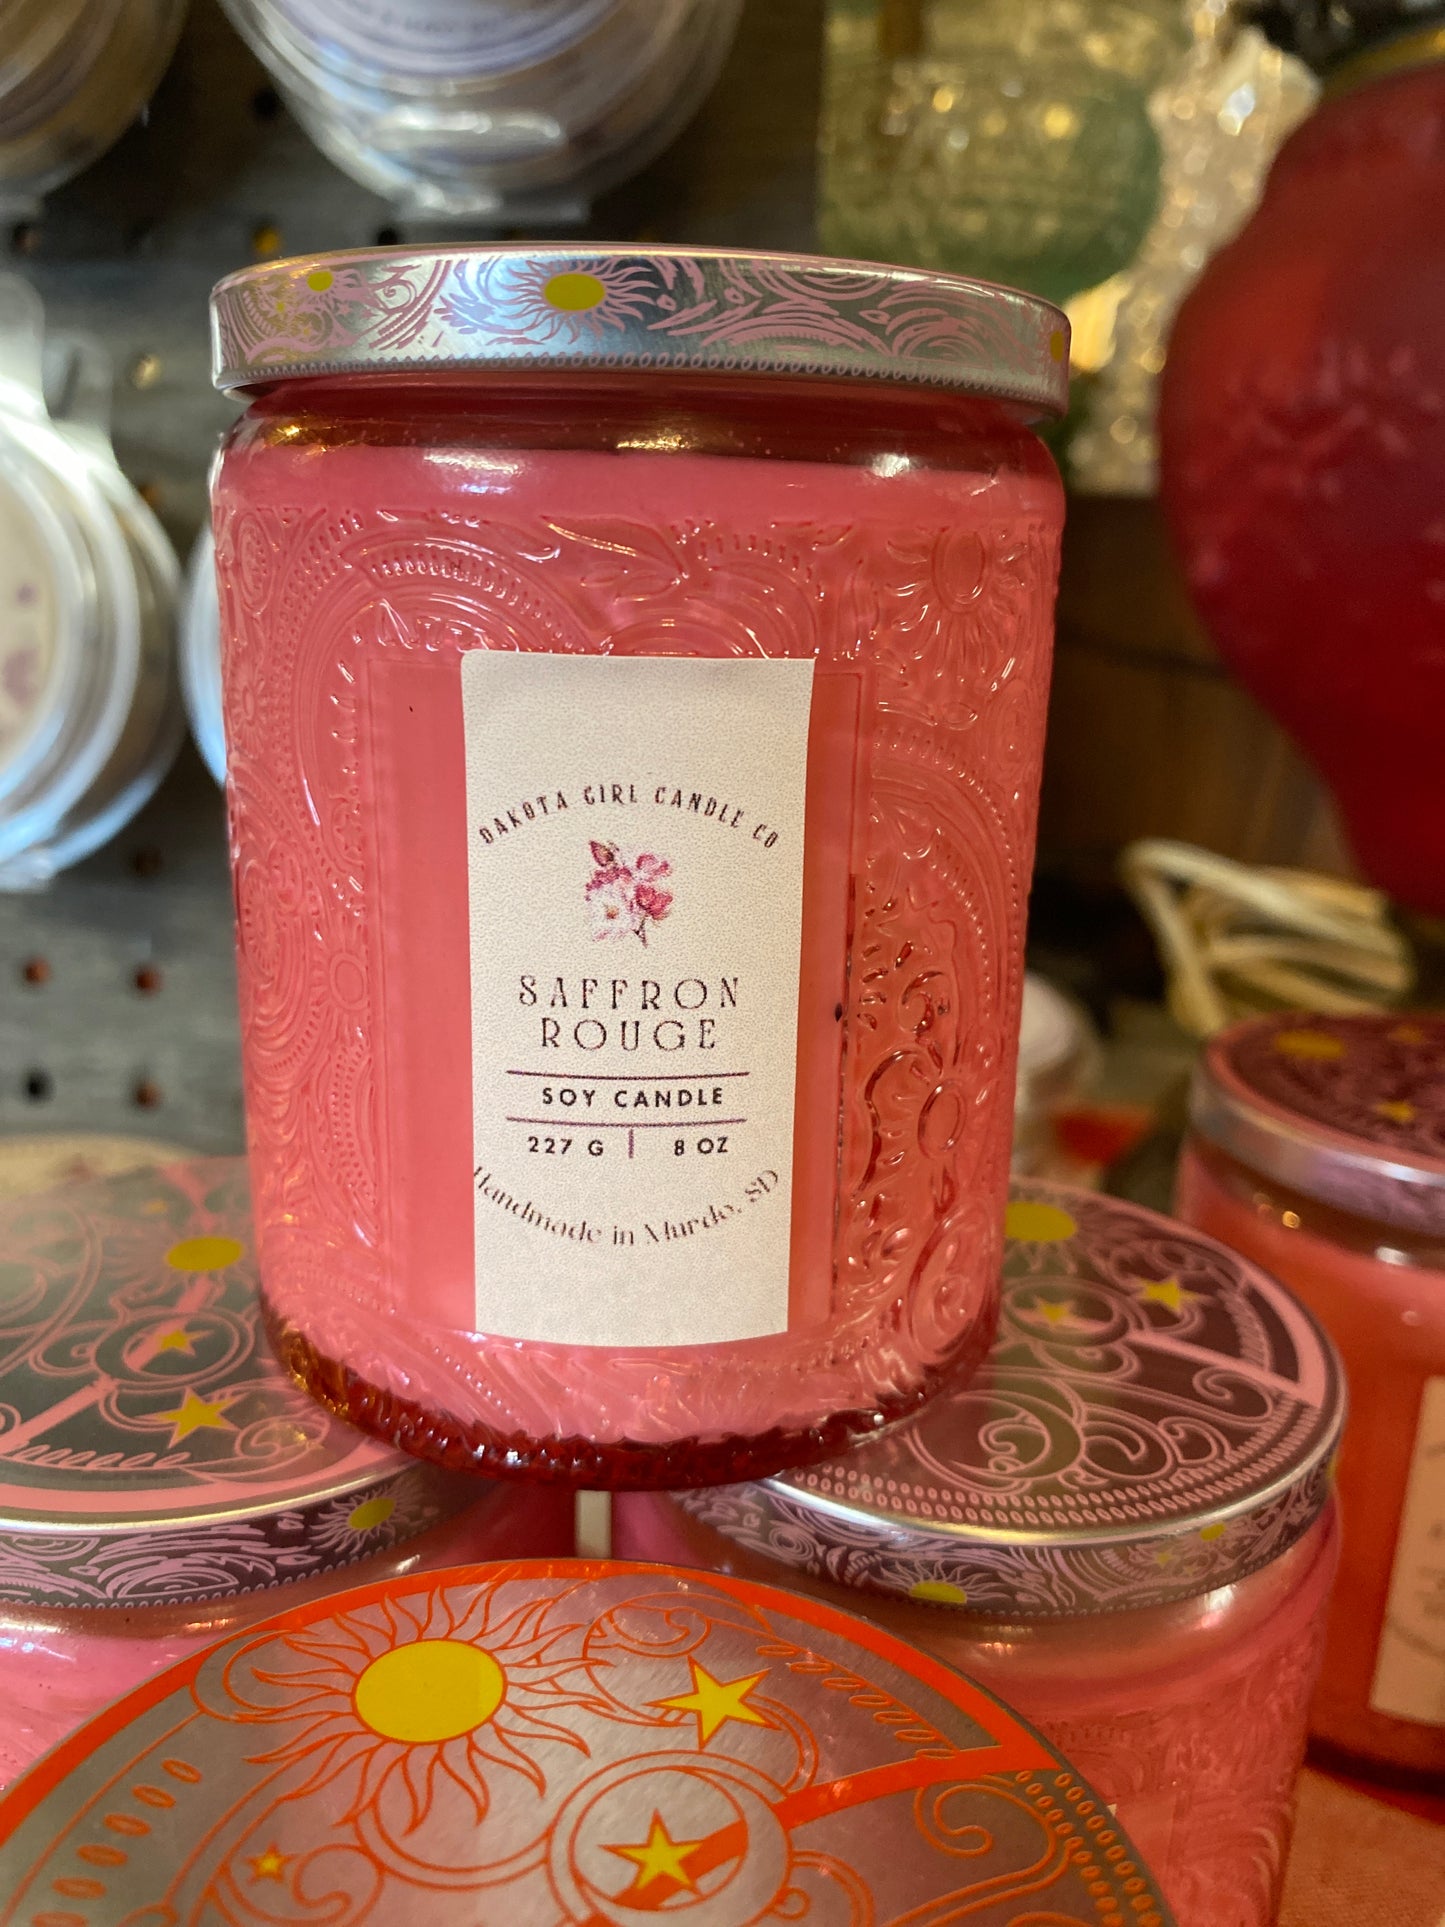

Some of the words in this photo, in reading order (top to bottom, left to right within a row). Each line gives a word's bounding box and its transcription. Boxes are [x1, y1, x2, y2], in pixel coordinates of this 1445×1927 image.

[479, 790, 568, 844] DAKOTA
[583, 784, 638, 806] GIRL
[654, 786, 745, 829] CANDLE
[752, 822, 781, 849] CO
[518, 974, 740, 1010] SAFFRON
[541, 1016, 717, 1051] ROUGE
[541, 1087, 596, 1107] SOY
[614, 1087, 724, 1109] CANDLE
[527, 1136, 573, 1155] 227
[587, 1139, 605, 1156] G
[673, 1139, 685, 1156] 8
[697, 1136, 729, 1155] OZ
[473, 1165, 602, 1244] Handmade
[612, 1225, 635, 1246] in
[744, 1169, 780, 1203] SD
